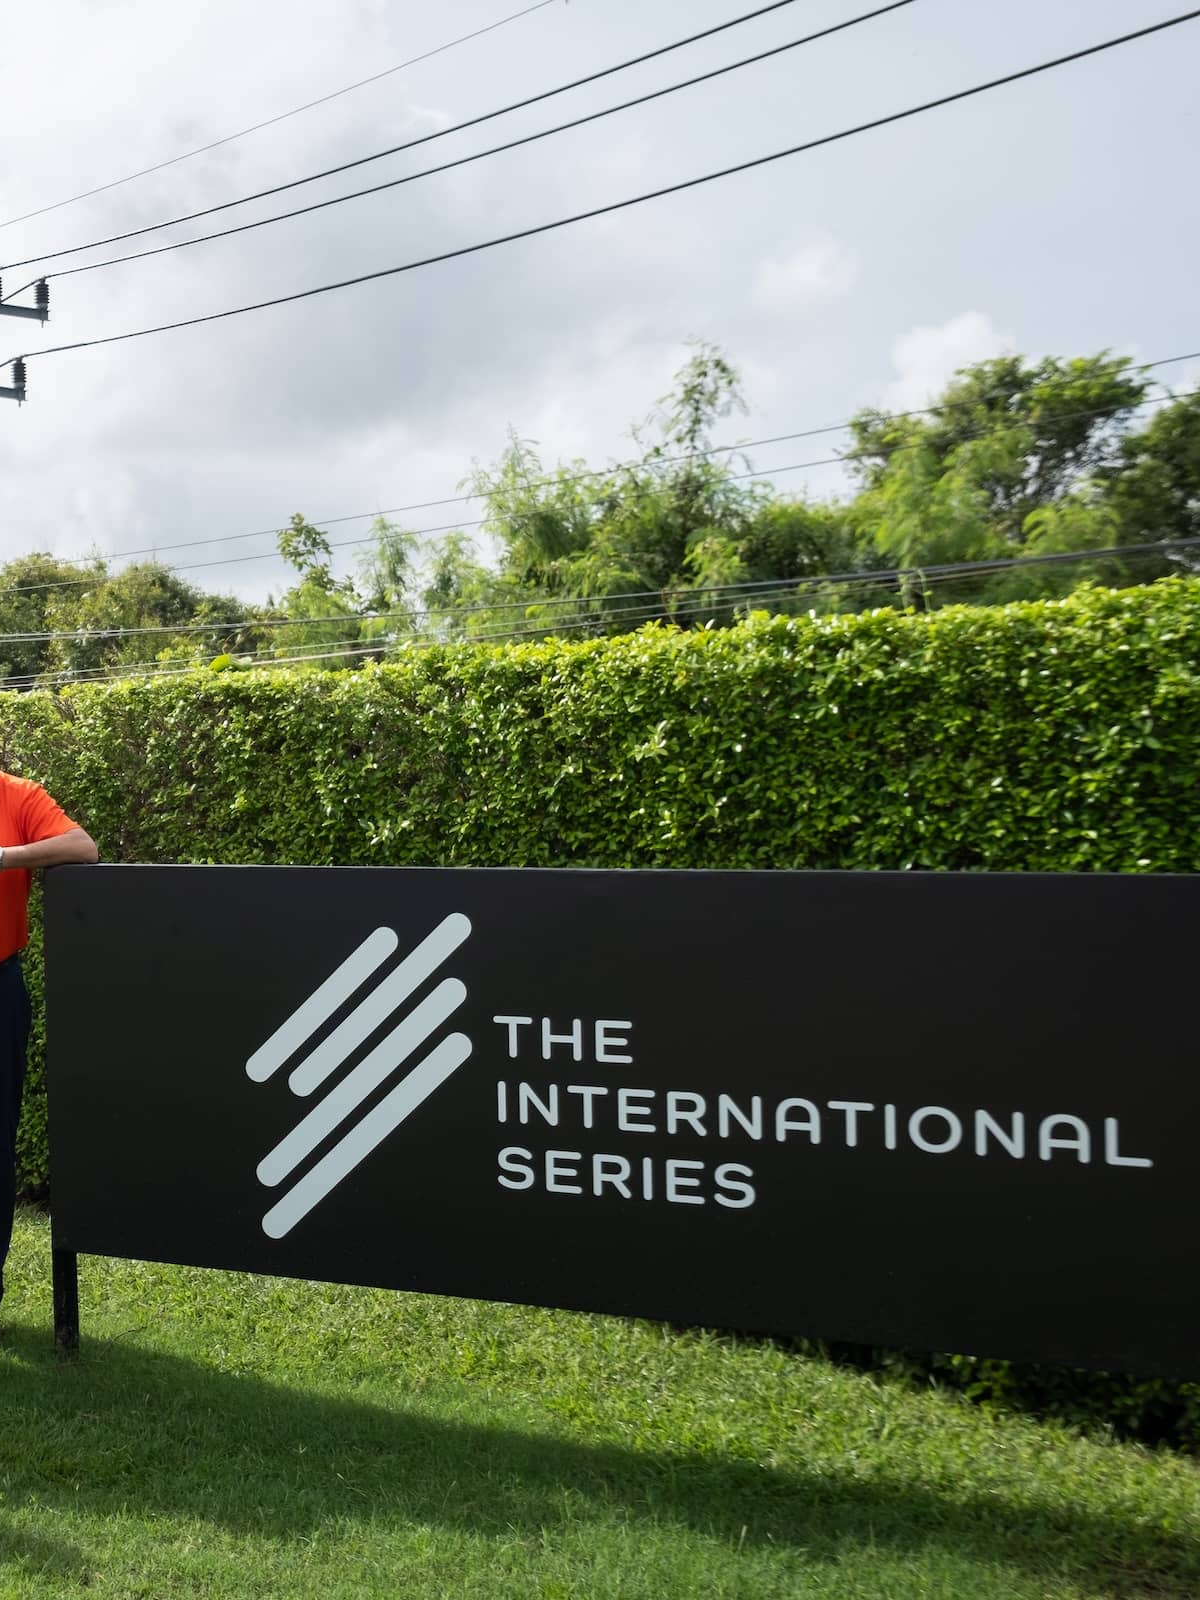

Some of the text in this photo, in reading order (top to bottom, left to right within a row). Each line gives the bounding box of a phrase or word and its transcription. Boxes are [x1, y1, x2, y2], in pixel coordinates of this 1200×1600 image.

[493, 1015, 634, 1065] THE
[496, 1079, 1154, 1169] INTERNATIONAL
[497, 1146, 756, 1209] SERIES
